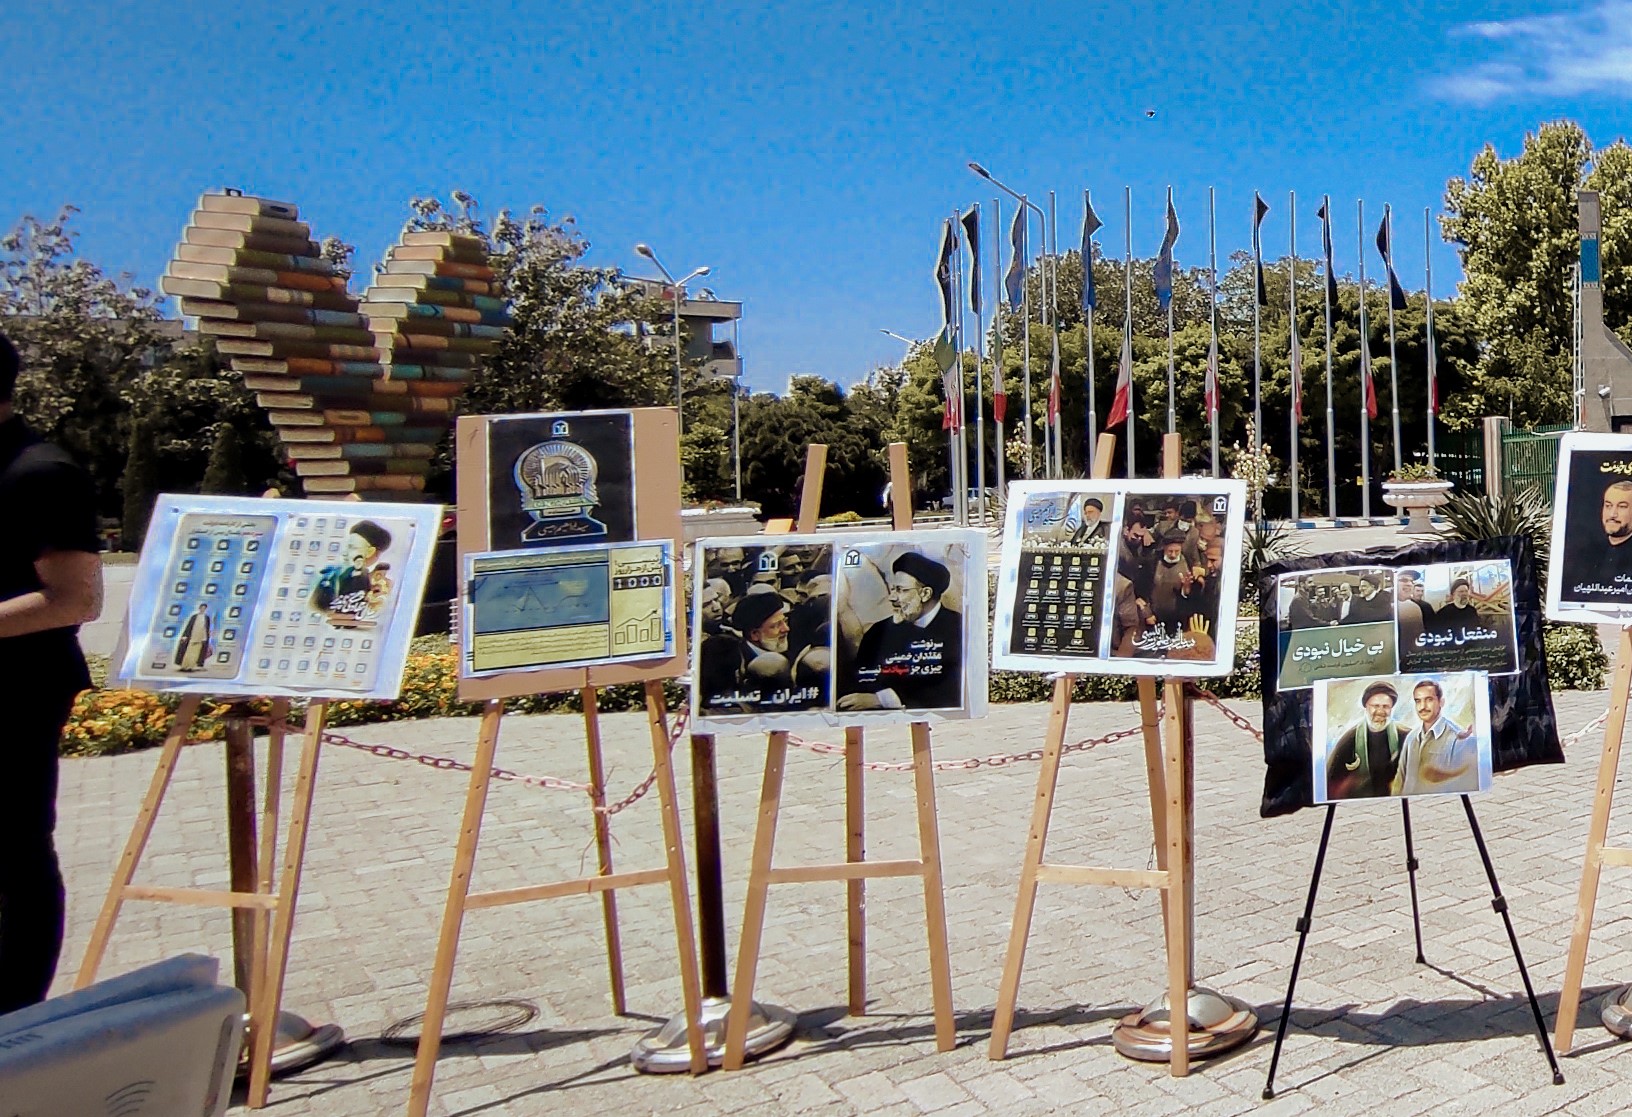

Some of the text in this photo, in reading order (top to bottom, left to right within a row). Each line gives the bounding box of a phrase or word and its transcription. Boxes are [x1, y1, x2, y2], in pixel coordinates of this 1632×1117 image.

[615, 575, 661, 588] 1000
[1415, 626, 1498, 647] منفعل نبودی
[910, 639, 944, 650] سرنوشت
[1292, 638, 1384, 661] بی خیال نبودی
[885, 652, 943, 665] مقلدان خمینی
[858, 664, 882, 675] نیست
[910, 664, 922, 676] جز
[921, 664, 944, 676] چیزی
[709, 686, 819, 708] #ایران_تسلیت
